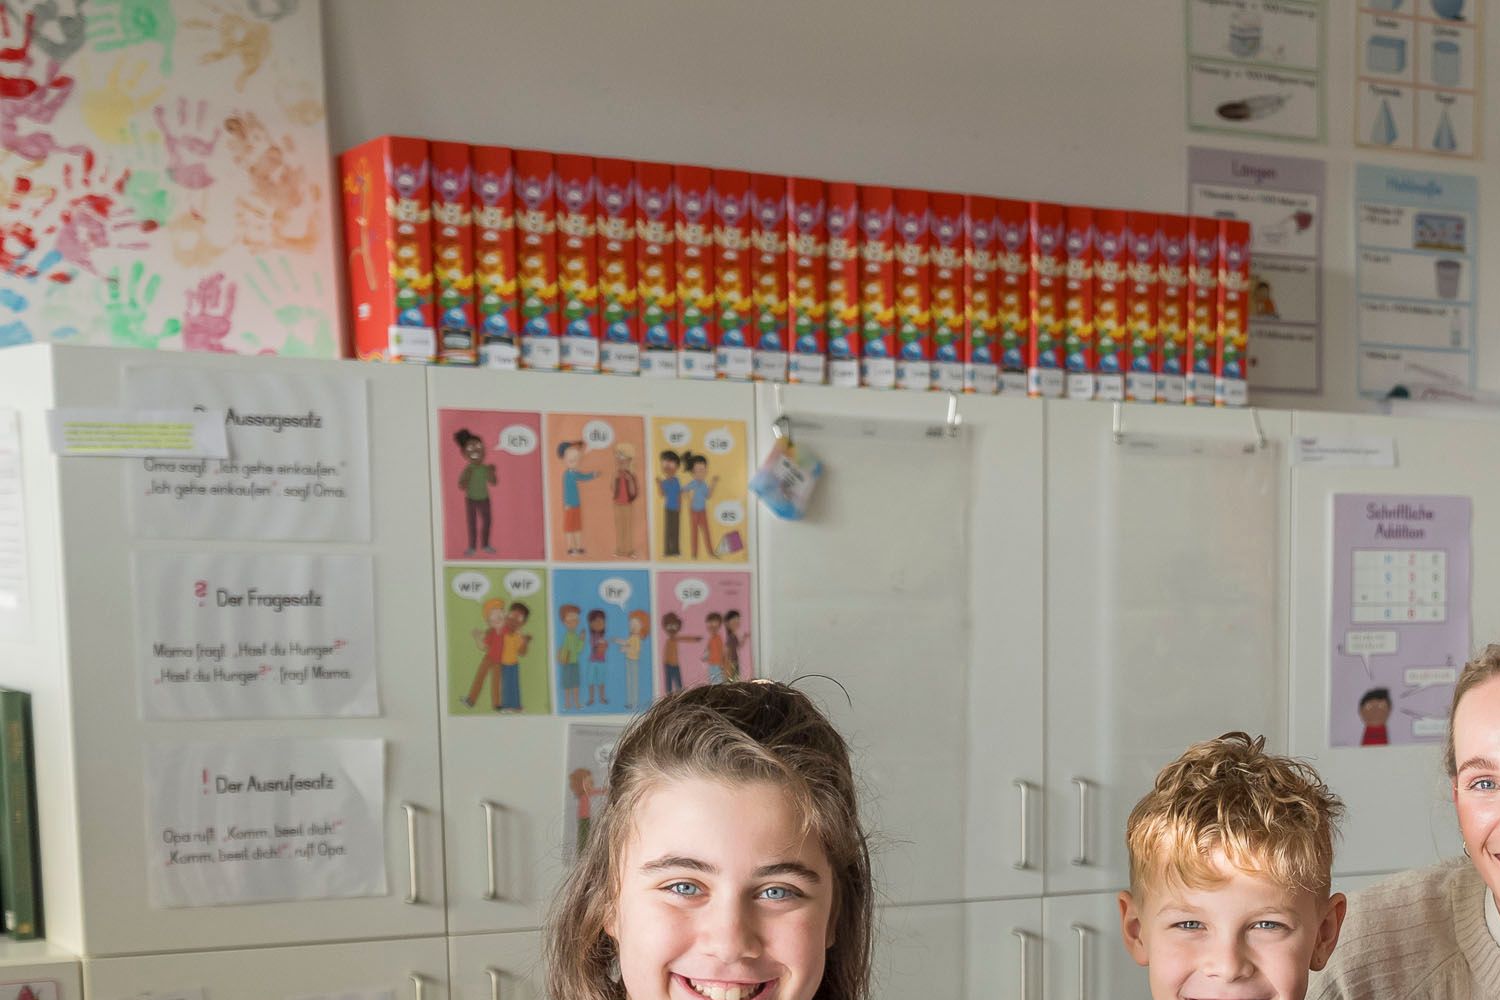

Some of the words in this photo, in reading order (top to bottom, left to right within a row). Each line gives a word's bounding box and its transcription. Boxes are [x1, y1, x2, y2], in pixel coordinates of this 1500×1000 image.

[225, 407, 322, 432] Aussagesatz
[508, 434, 529, 447] ich
[590, 429, 607, 442] du
[669, 432, 684, 442] er
[709, 437, 729, 450] sie
[241, 460, 274, 478] gehe
[175, 481, 206, 499] gehe
[458, 581, 482, 592] wir
[511, 579, 534, 590] wir
[605, 586, 624, 599] ihr
[682, 587, 702, 599] sie
[216, 587, 243, 607] Der
[247, 587, 323, 612] Fragesatz
[153, 643, 193, 658] Mama
[271, 643, 286, 656] du
[193, 669, 210, 682] du
[216, 777, 243, 794] Der
[247, 773, 336, 796] Ausrufesatz
[163, 829, 191, 846] Opa
